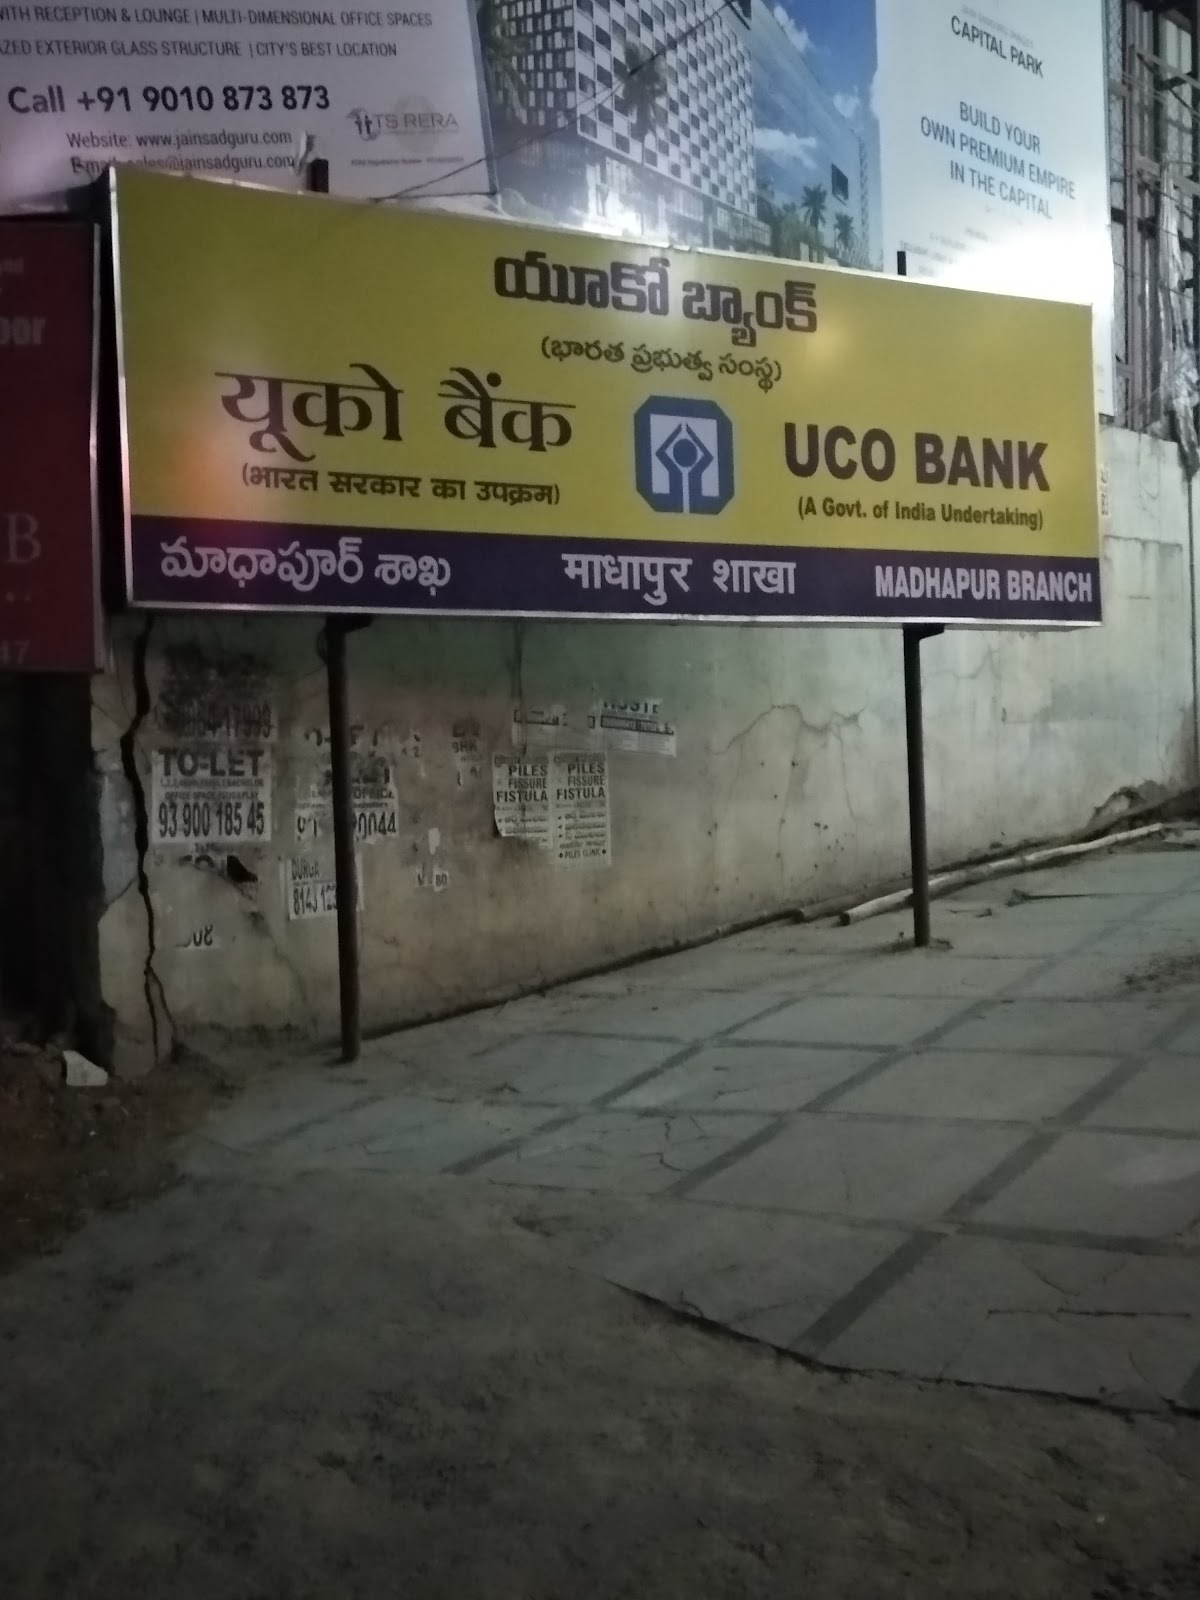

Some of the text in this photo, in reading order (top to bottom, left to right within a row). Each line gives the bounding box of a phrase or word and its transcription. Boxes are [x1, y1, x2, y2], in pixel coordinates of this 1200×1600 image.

[35, 6, 118, 23] RECEPTION
[121, 8, 131, 23] &
[135, 8, 191, 24] LOUNGE
[203, 9, 335, 26] MULTI-DIMENSIONAL
[341, 11, 382, 26] OFFICE
[387, 12, 433, 27] SPACES
[36, 40, 108, 56] EXTERIOR
[110, 40, 158, 56] GLASS
[161, 41, 243, 57] STRUCTURE
[256, 41, 297, 57] CITY'S
[302, 42, 332, 57] BEST
[336, 42, 397, 57] LOCATION
[951, 15, 1007, 60] CAPITAL
[1010, 45, 1044, 79] PARK
[8, 85, 330, 113] Call +91 9010 873 873
[403, 112, 460, 129] RERA
[959, 101, 1041, 155] BUILD YOUR
[66, 130, 293, 150] Website: www.jainsadguru.com
[920, 116, 1076, 200] OWN PREMIUM EMPIRE
[950, 160, 1053, 220] IN THE CAPITAL
[215, 363, 576, 463] यूको बैंक
[784, 422, 1050, 492] UCO BANK
[242, 462, 561, 506] (भारत सरकार का उपक्रम)
[798, 495, 1044, 531] (A Govt. of India Undertaking)
[561, 553, 796, 606] माधापुर शाखा
[875, 565, 1093, 602] MADHAPUR BRANCH
[158, 747, 265, 777] TO-LET
[508, 764, 547, 777] PILES
[567, 762, 605, 775] PILES
[496, 790, 548, 803] FISTULA
[556, 787, 606, 801] FISTULA
[158, 802, 178, 838] 93
[182, 802, 211, 838] 900
[216, 802, 243, 836] 185
[247, 801, 265, 836] 45
